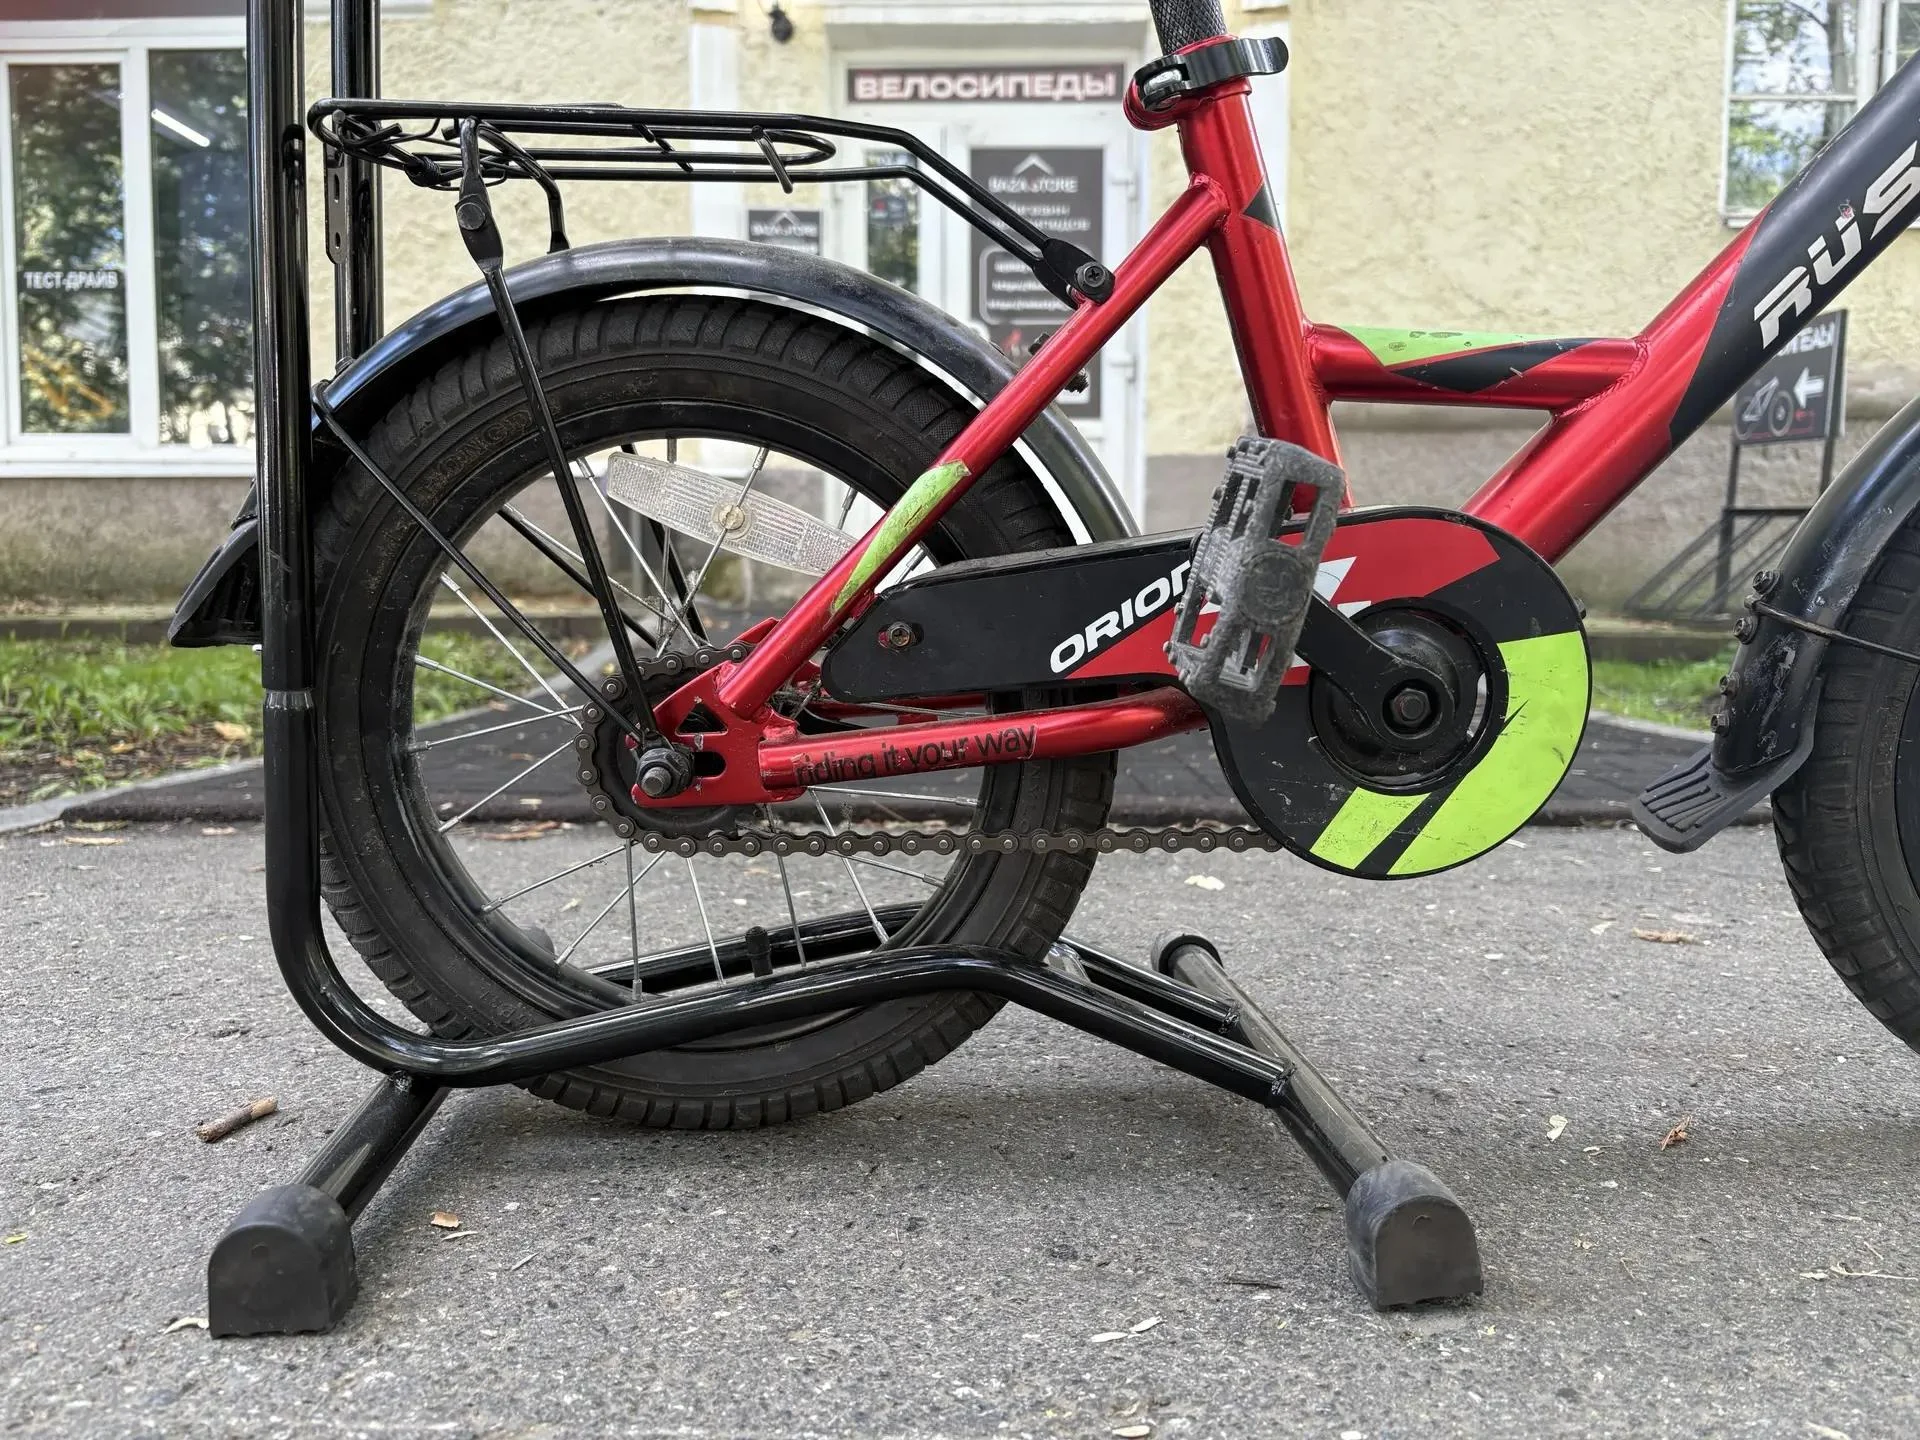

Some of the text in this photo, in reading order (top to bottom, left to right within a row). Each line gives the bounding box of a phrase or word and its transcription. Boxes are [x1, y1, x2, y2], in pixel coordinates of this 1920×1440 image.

[854, 73, 1117, 100] ВЕЛОСИПЕДЫ
[23, 270, 118, 291] ТЕСТ-ДРАЙВ
[796, 724, 1037, 784] riding it your way
